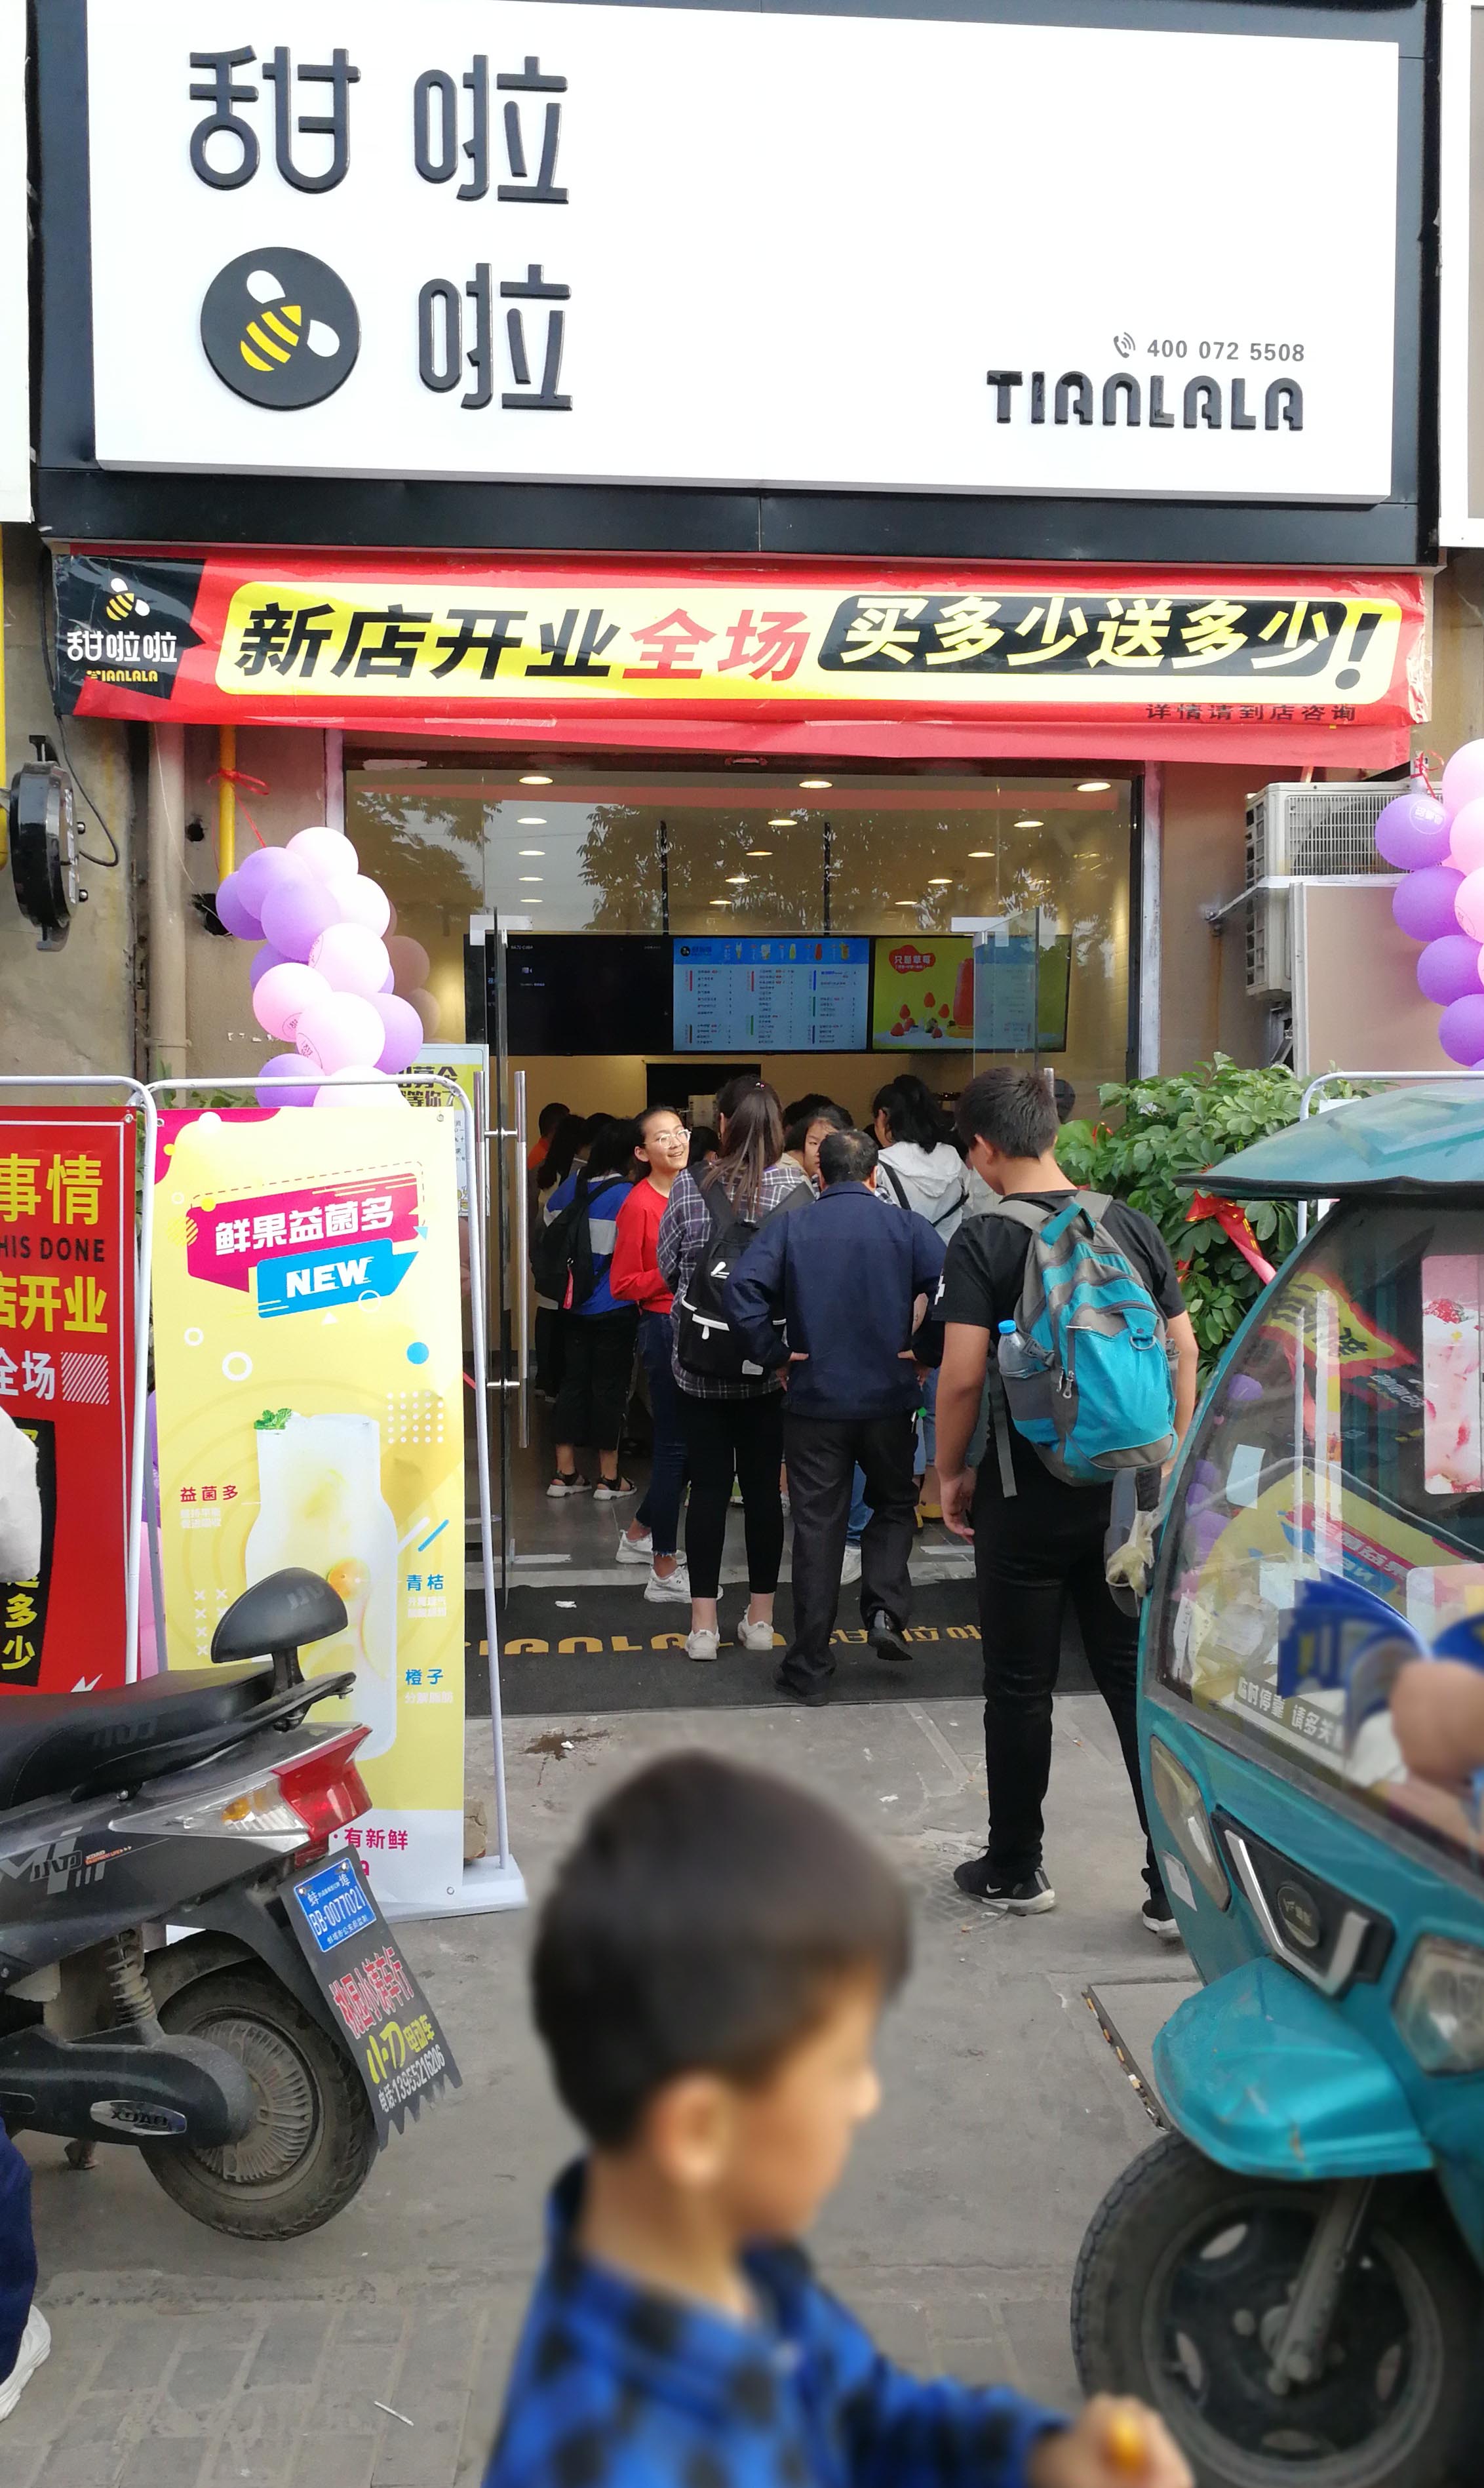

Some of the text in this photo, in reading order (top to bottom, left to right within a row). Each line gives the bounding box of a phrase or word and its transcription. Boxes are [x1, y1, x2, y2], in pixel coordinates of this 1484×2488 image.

[418, 263, 573, 411] 啦
[1147, 340, 1305, 362] 400 072 5508
[986, 370, 1303, 431] TIANLALA
[67, 631, 178, 663] 甜啦啦
[1145, 703, 1356, 722] 详情请到店咨询
[0, 1153, 104, 1225] 事情
[214, 1195, 394, 1256] 鲜果益菌多
[40, 1236, 106, 1263] DONE
[286, 1255, 374, 1299] NEW
[180, 1485, 239, 1503] 益菌多
[406, 1573, 444, 1591] 青桔
[404, 1669, 444, 1686] 橙子
